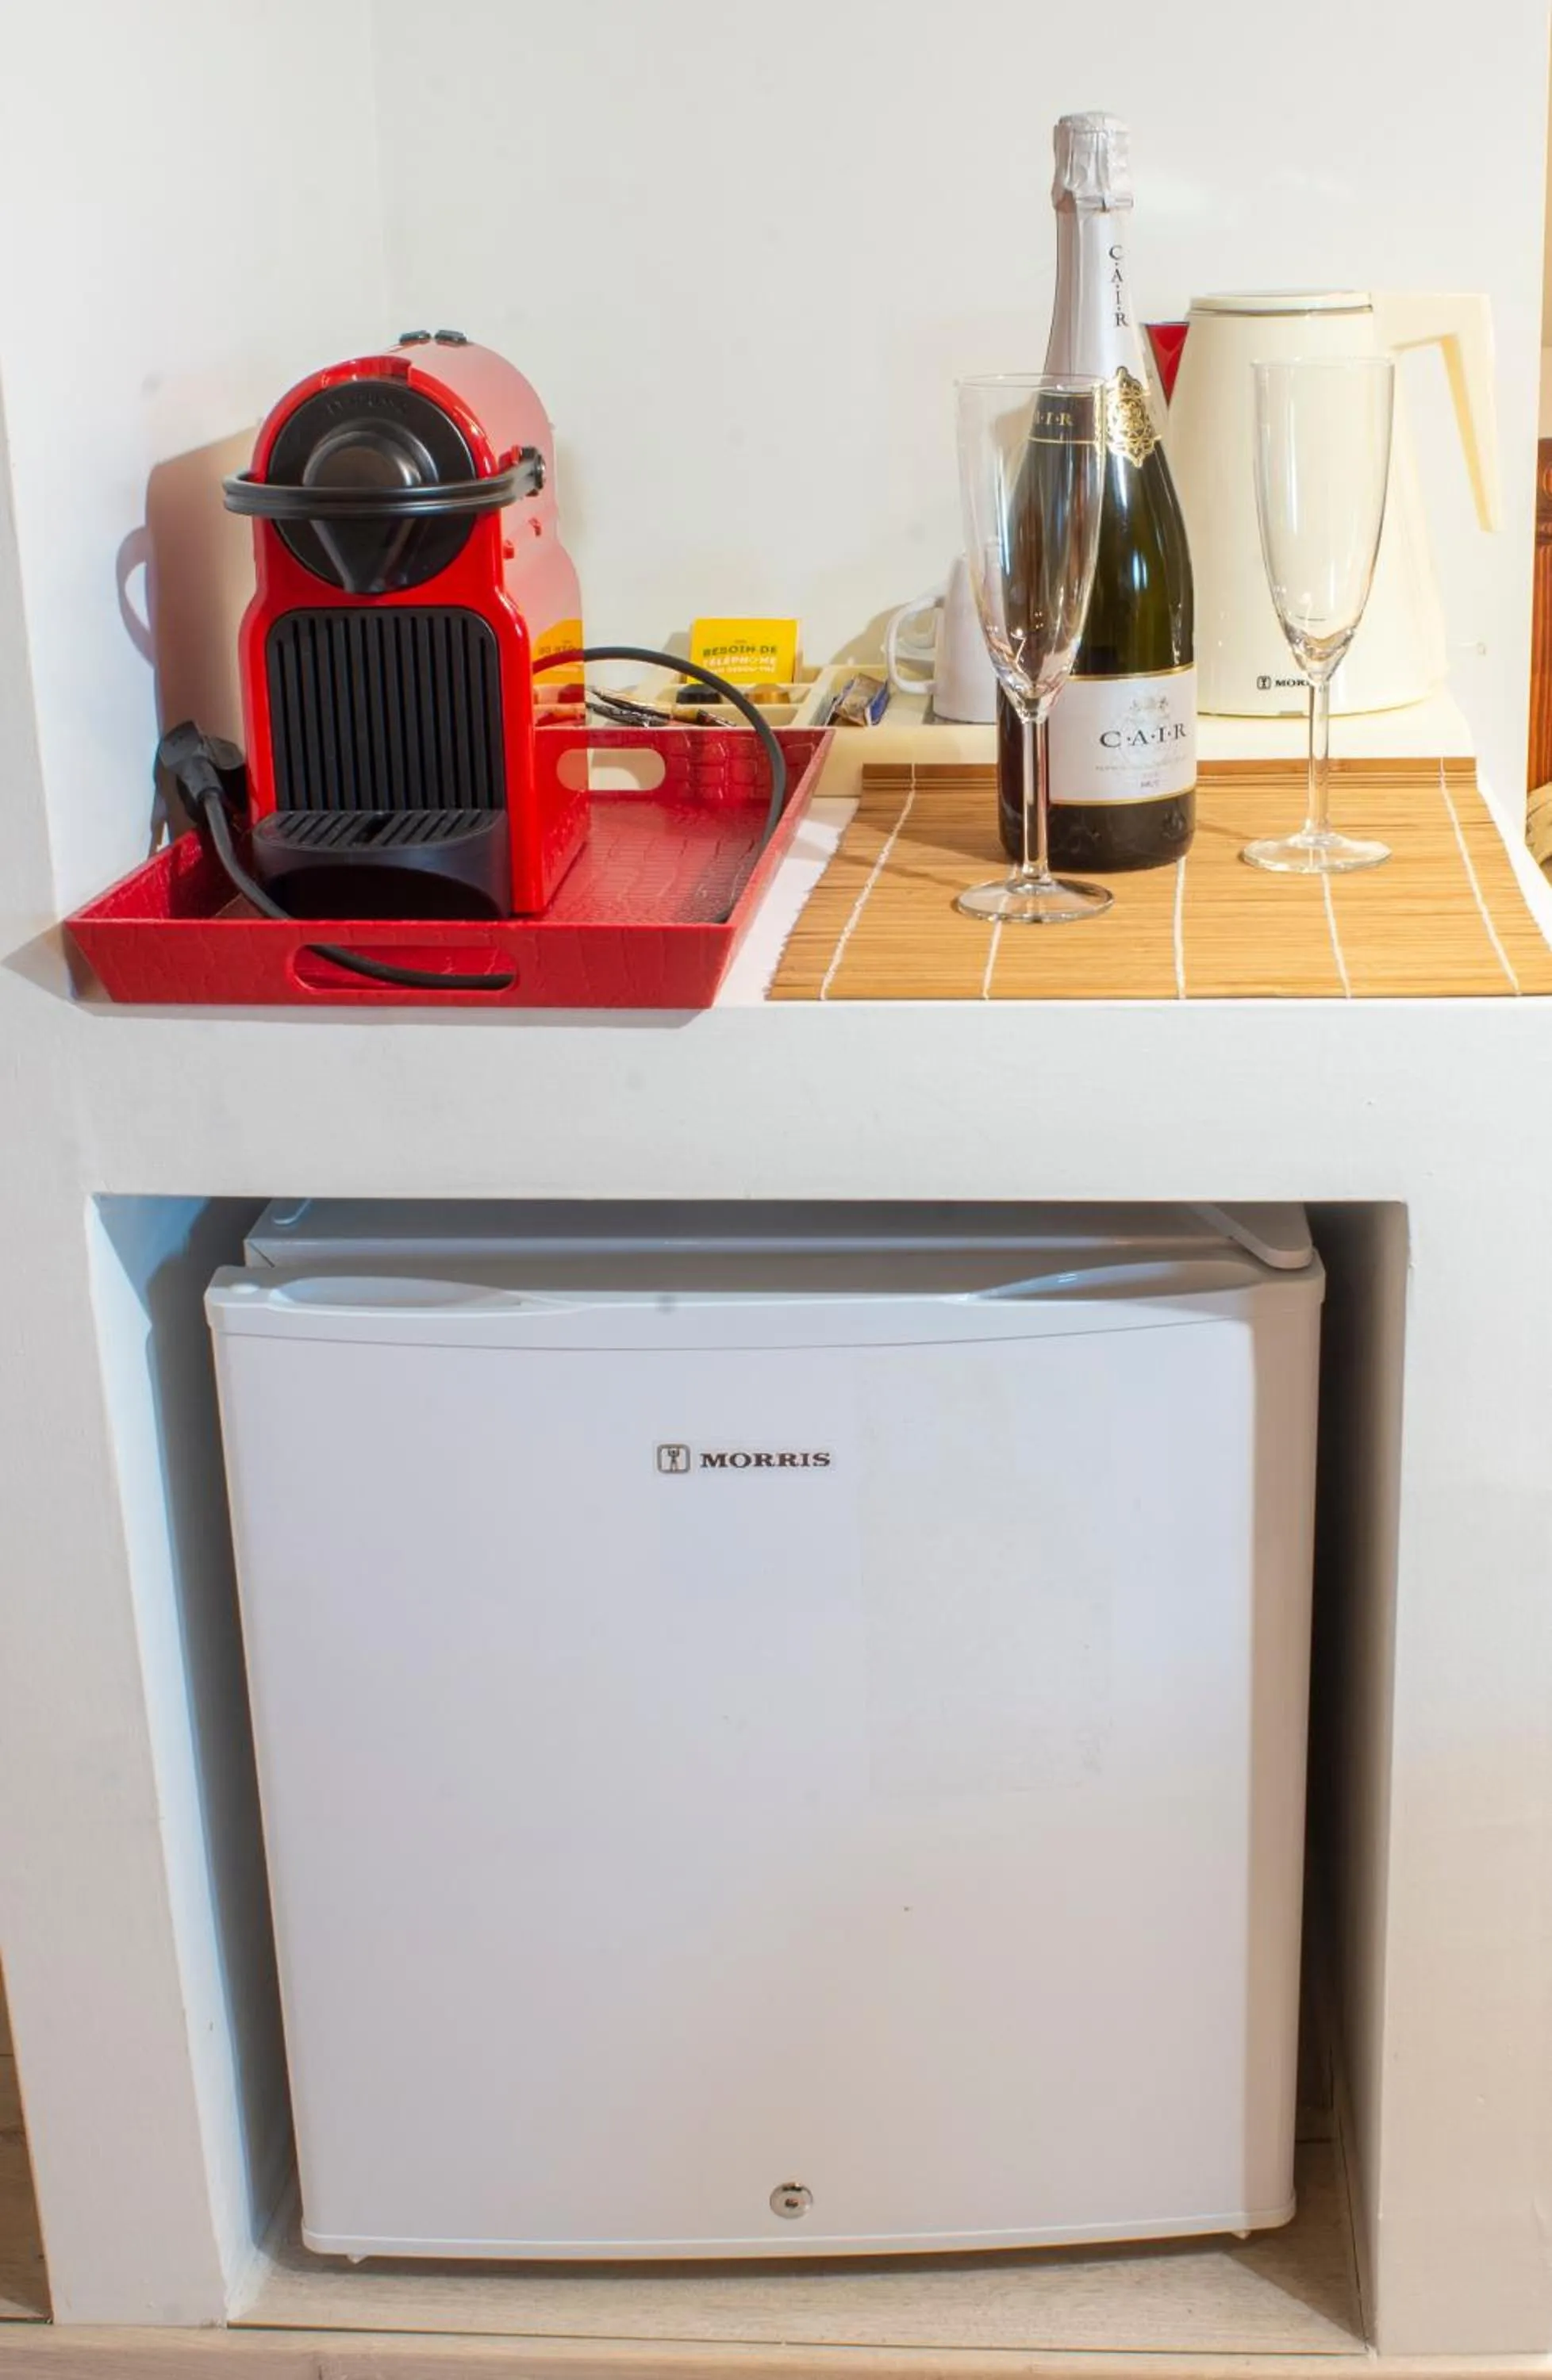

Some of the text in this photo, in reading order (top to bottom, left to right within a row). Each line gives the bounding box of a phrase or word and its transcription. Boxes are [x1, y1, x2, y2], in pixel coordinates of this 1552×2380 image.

[703, 645, 777, 657] BESOIN DE
[700, 1453, 831, 1468] MORRIS
